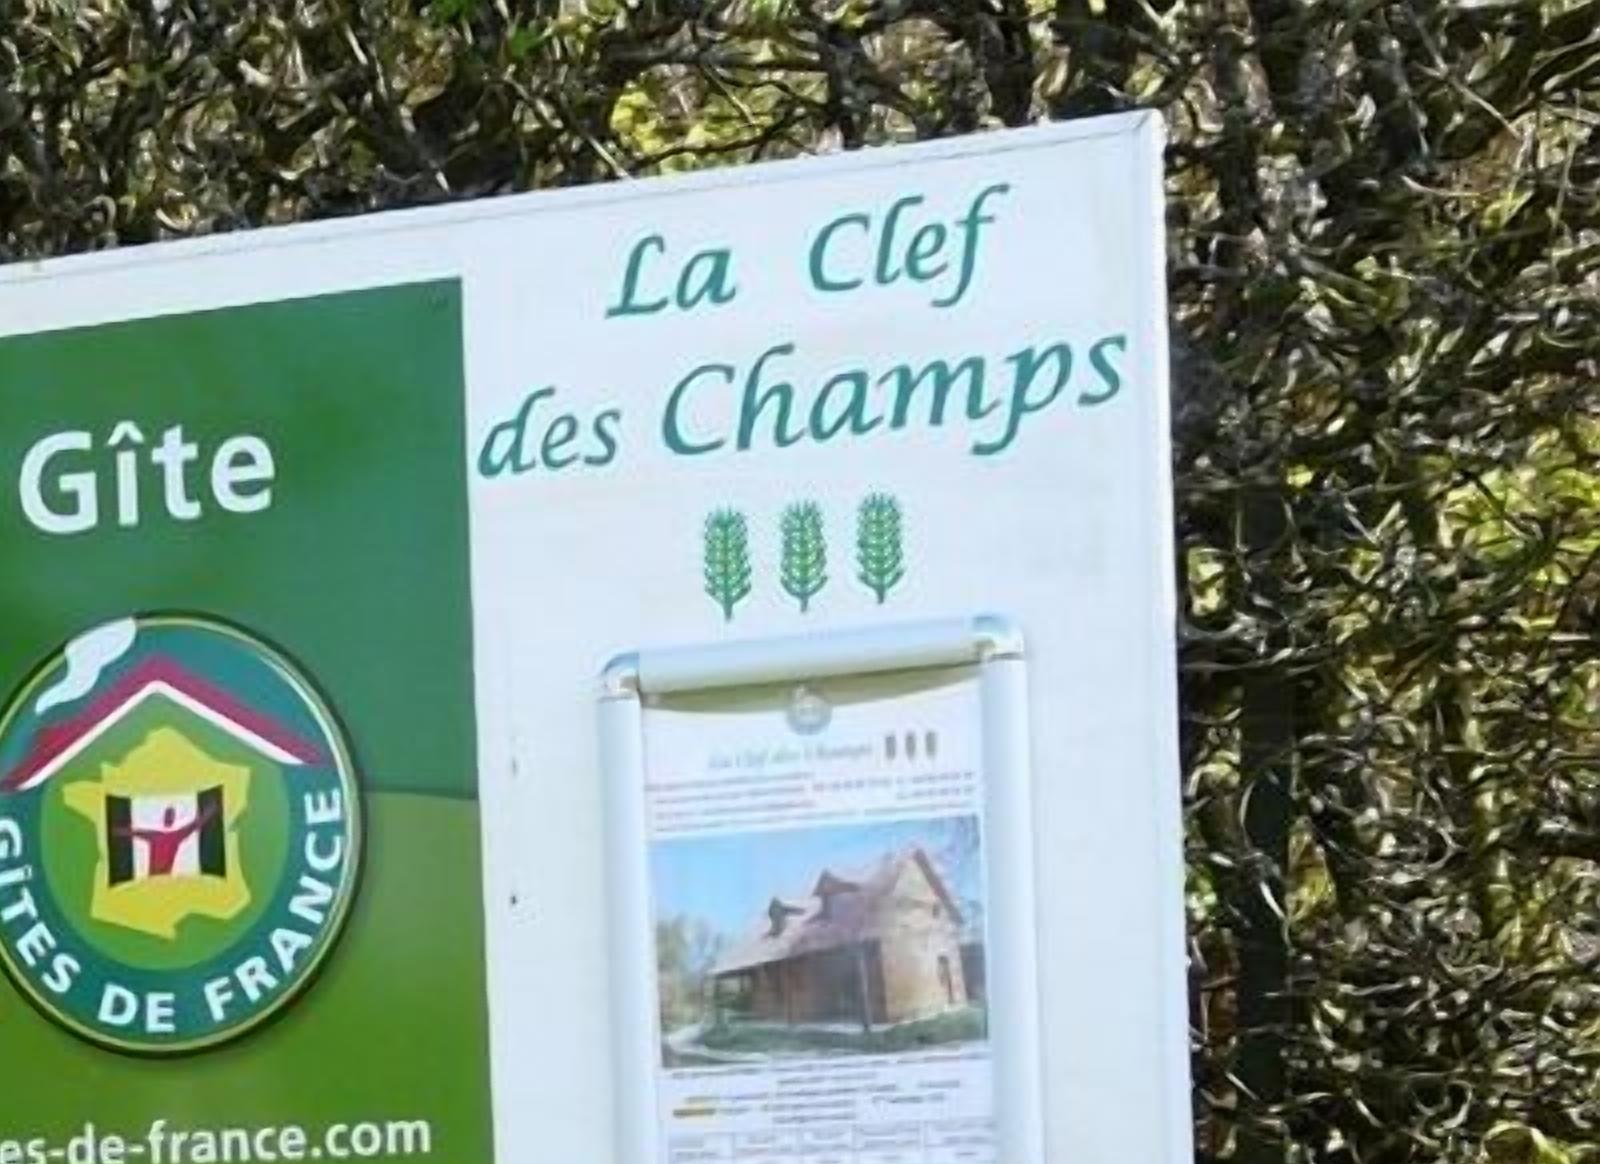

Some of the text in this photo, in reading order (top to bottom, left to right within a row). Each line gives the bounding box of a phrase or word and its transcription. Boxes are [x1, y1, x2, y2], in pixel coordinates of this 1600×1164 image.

[606, 183, 1010, 318] La Clef
[19, 420, 275, 533] Gîte
[476, 335, 1128, 479] des Champs
[98, 984, 176, 1034] DE
[204, 787, 343, 1022] FRANCE
